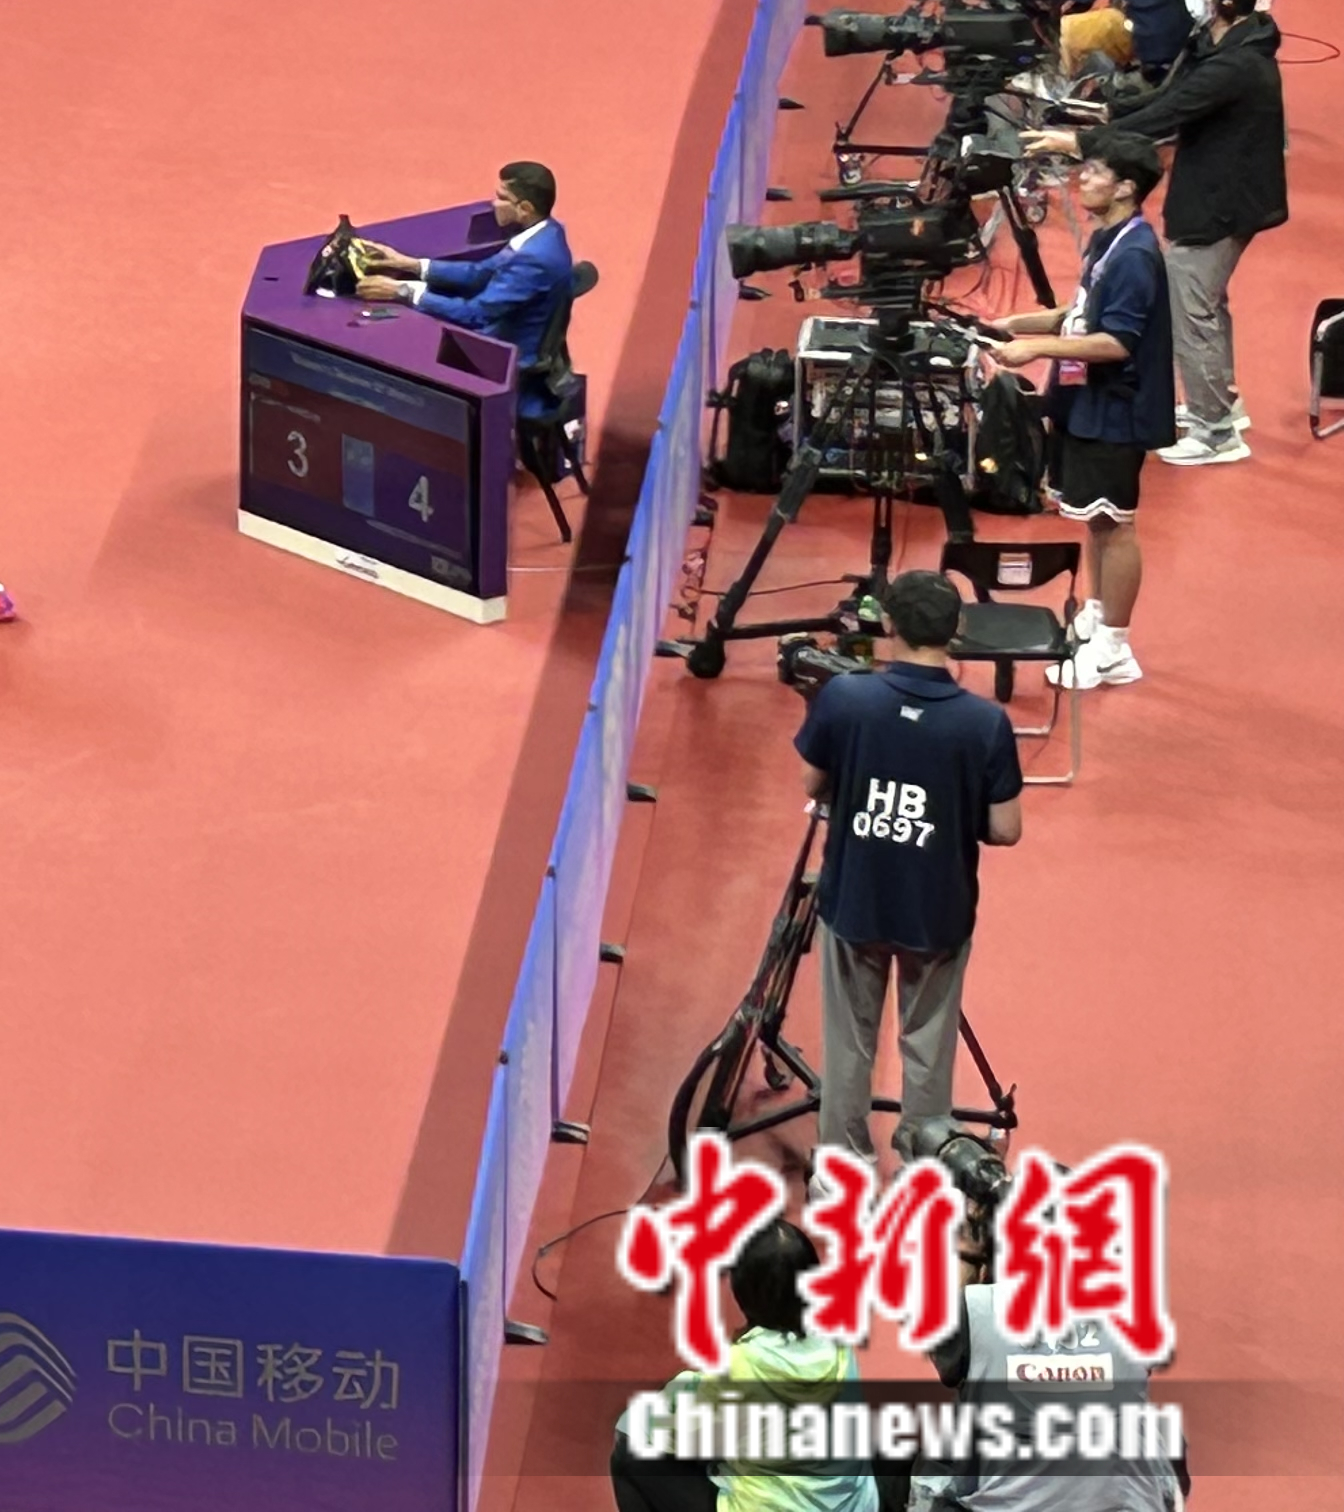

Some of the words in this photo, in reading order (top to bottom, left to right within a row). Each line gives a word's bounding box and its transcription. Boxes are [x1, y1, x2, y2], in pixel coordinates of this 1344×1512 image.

[286, 430, 309, 478] 3
[408, 475, 434, 523] 4
[866, 778, 927, 820] HB
[853, 811, 935, 848] 0697
[107, 1329, 399, 1409] 中国移动
[1016, 1363, 1105, 1383] Canon
[108, 1402, 237, 1446] China
[252, 1413, 398, 1461] Mobile
